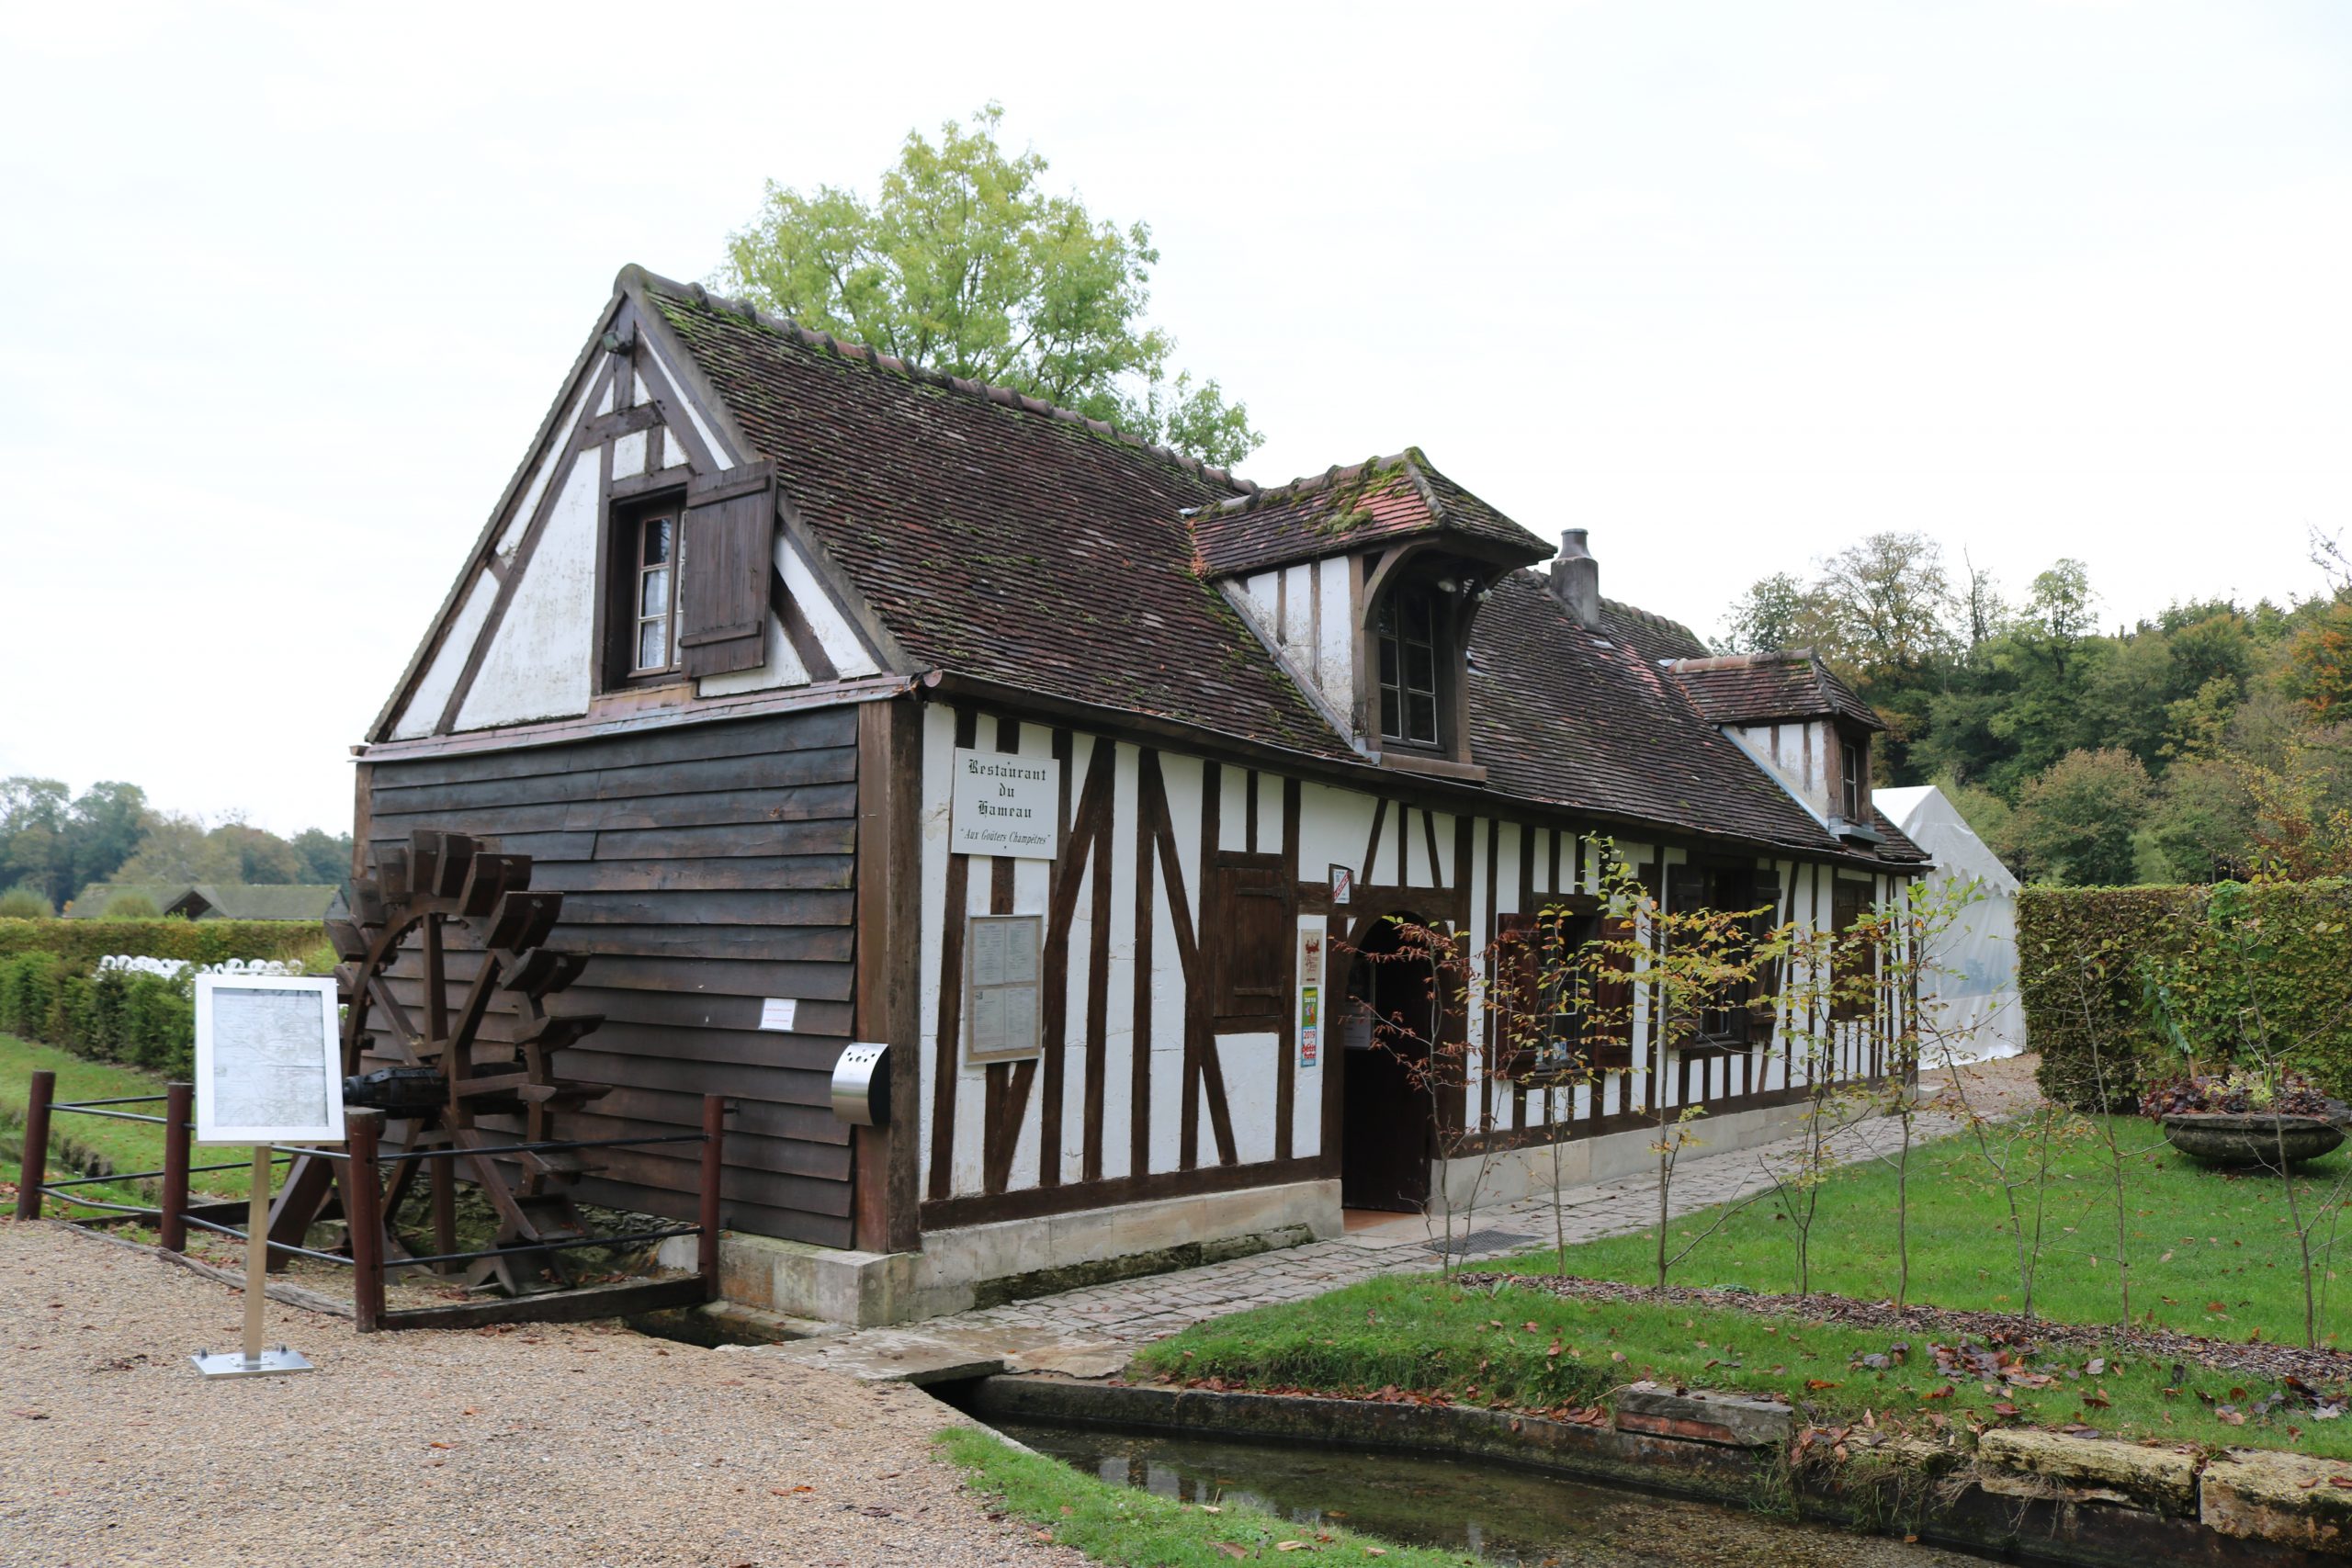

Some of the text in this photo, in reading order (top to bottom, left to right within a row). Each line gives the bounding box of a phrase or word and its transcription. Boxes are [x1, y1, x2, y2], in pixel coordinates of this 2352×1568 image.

[968, 759, 1046, 781] Restaurant
[999, 783, 1014, 798] du
[978, 800, 1032, 818] Hameau
